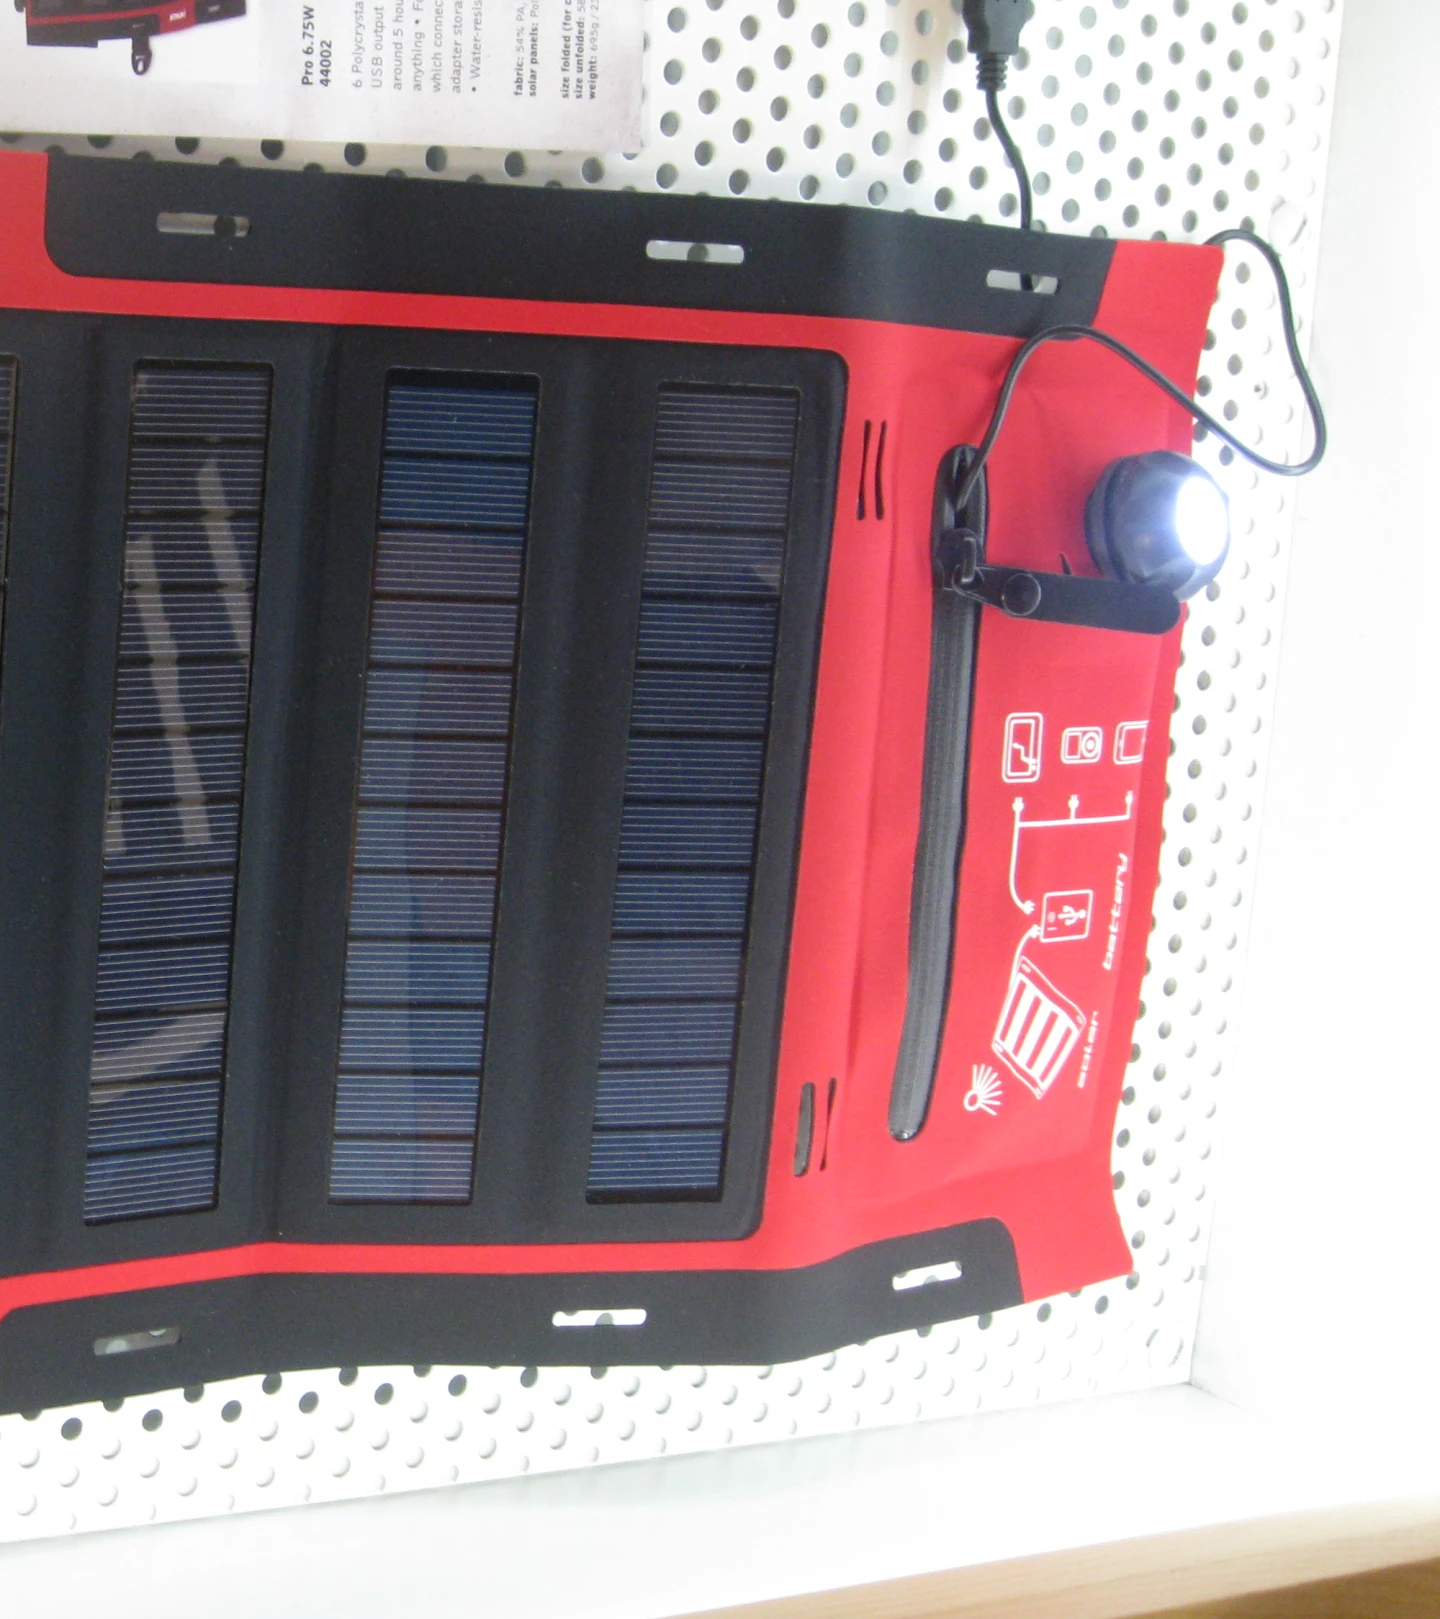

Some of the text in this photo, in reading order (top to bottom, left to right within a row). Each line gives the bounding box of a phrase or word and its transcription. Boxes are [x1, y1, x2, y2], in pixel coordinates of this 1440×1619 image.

[393, 27, 404, 37] 5
[562, 9, 573, 32] (for
[590, 22, 600, 51] 695g
[301, 5, 315, 86] Pro 6.75W
[319, 40, 332, 87] 44002
[371, 5, 385, 88] USB output
[412, 31, 426, 91] anything
[513, 2, 528, 96] fabric: 54% PA,
[529, 22, 540, 65] panels:
[561, 35, 571, 72] folded
[575, 17, 586, 73] unfolded:
[352, 79, 363, 88] 6
[392, 42, 404, 90] around
[430, 52, 443, 93] which
[450, 40, 464, 93] adapter
[527, 70, 538, 97] solar
[587, 56, 599, 99] weight:
[560, 77, 570, 99] size
[574, 77, 584, 99] size
[1102, 852, 1128, 971] battery
[1077, 1010, 1100, 1089] solar
